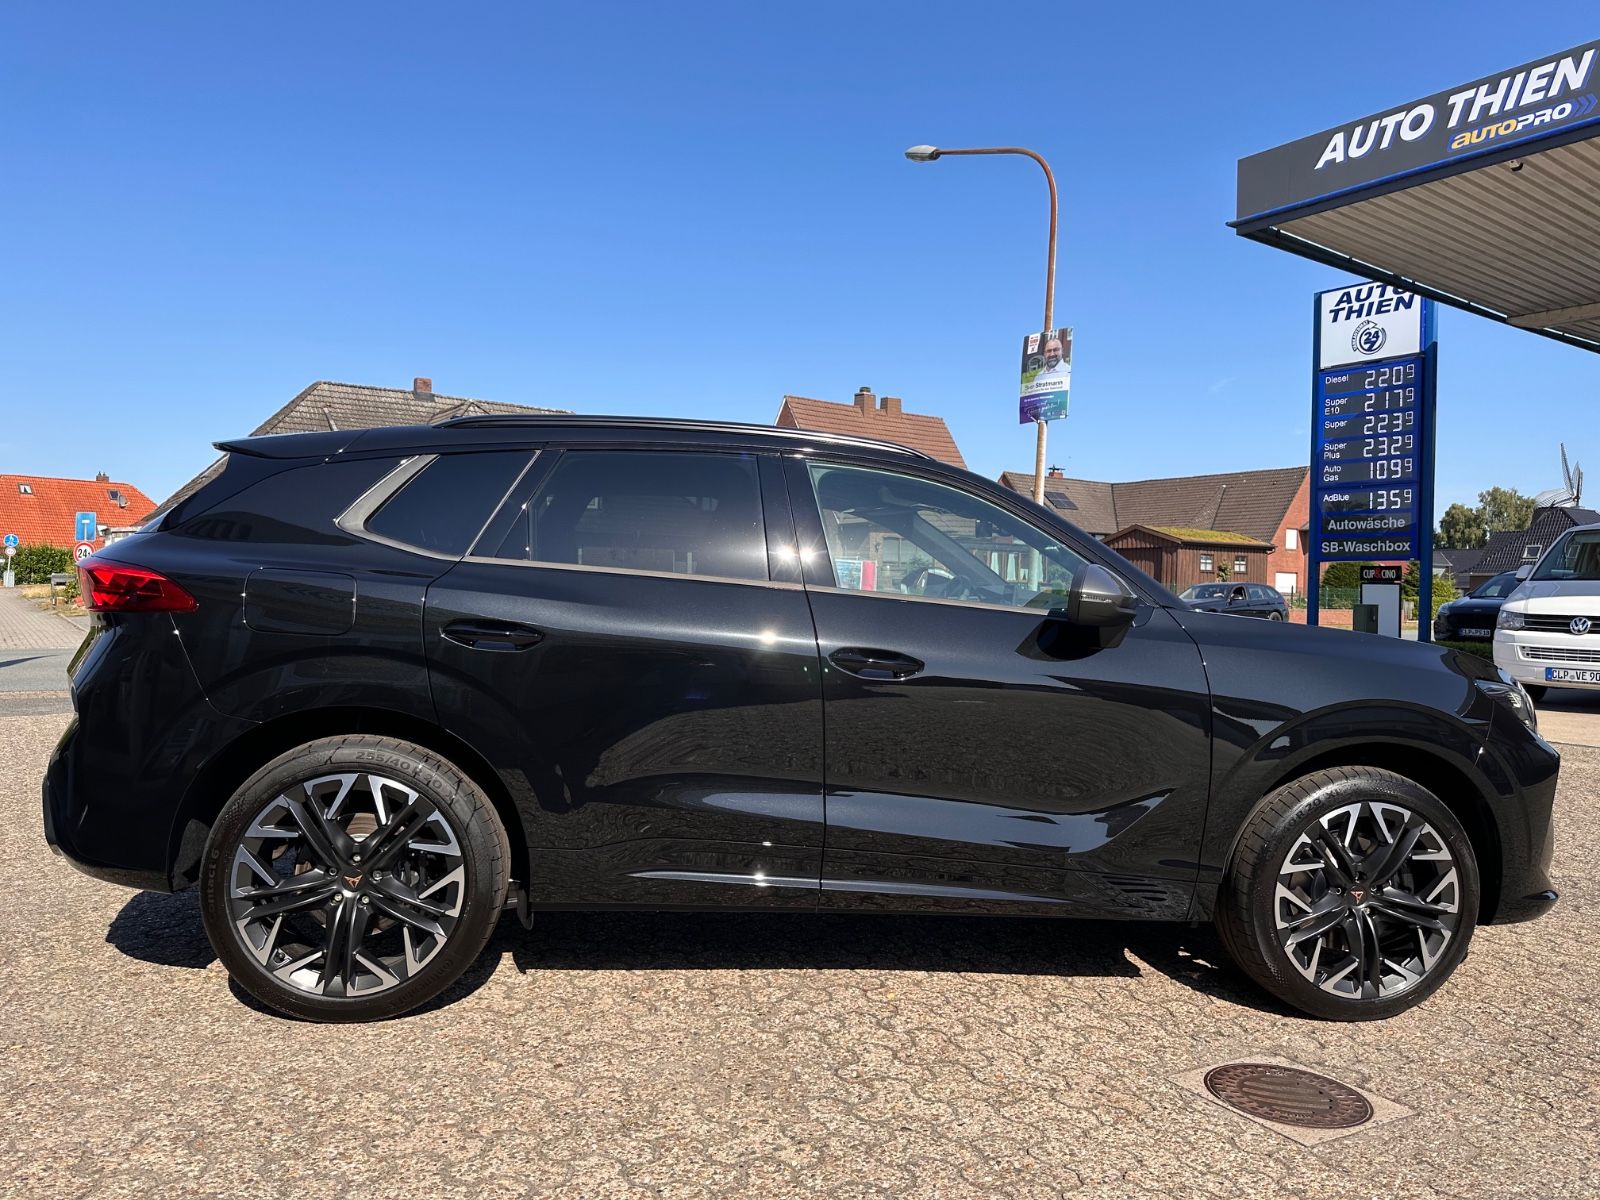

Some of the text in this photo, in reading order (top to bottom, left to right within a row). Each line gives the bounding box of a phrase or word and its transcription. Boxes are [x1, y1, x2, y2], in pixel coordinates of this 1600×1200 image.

[1314, 49, 1597, 170] AUTO THIEN
[1329, 293, 1415, 323] THIEN
[1364, 330, 1380, 342] 24
[1325, 374, 1349, 384] Diesel
[1325, 397, 1348, 408] Super
[1324, 407, 1340, 415] E10
[1324, 420, 1348, 430] Super
[1324, 442, 1347, 452] Super
[1324, 452, 1340, 460] Plus
[1324, 464, 1341, 473] Auto
[1324, 474, 1339, 482] Gas
[1323, 493, 1350, 502] AdBlue
[1328, 518, 1406, 531] Autowäsche
[1322, 540, 1410, 553] SB-Waschbox
[78, 549, 87, 558] 24
[1552, 670, 1569, 679] CLP
[1576, 671, 1587, 680] VE
[356, 751, 411, 771] 255/40
